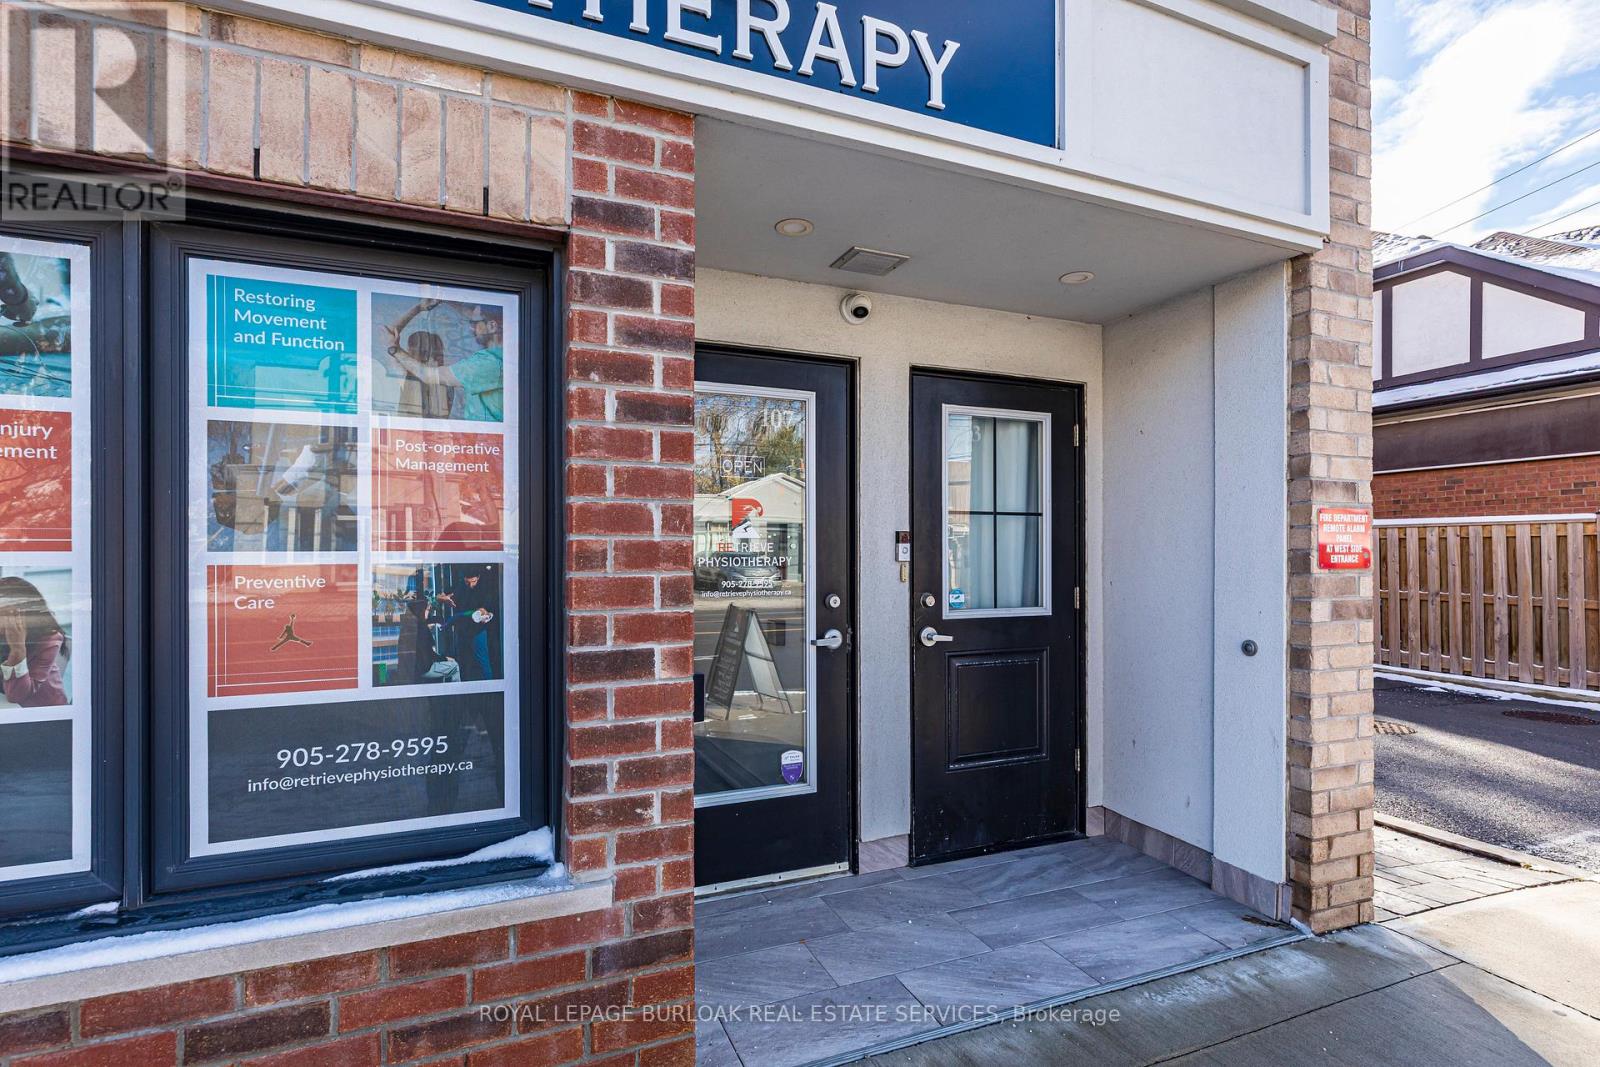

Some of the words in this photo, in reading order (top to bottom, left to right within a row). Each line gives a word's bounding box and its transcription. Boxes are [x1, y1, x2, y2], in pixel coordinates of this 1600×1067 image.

[528, 0, 961, 110] ERAPY
[234, 288, 316, 312] Restoring
[234, 308, 327, 330] Movement
[233, 331, 266, 345] and
[271, 332, 345, 351] Function
[0, 445, 58, 459] ment
[395, 439, 501, 456] Post-operative
[395, 457, 490, 474] Management
[722, 459, 763, 474] OPEN
[1319, 513, 1333, 522] FIRE
[717, 542, 774, 553] RETRIEVE
[1326, 544, 1333, 553] AT
[1334, 544, 1350, 553] WEST
[698, 556, 792, 567] PHYSIOTHERAPY
[1330, 554, 1359, 563] ENTRANCE
[234, 575, 326, 589] Preventive
[234, 596, 275, 610] Care
[276, 735, 449, 769] 905-278-9595
[247, 760, 474, 792] info@retrievephysiotherapy.ca
